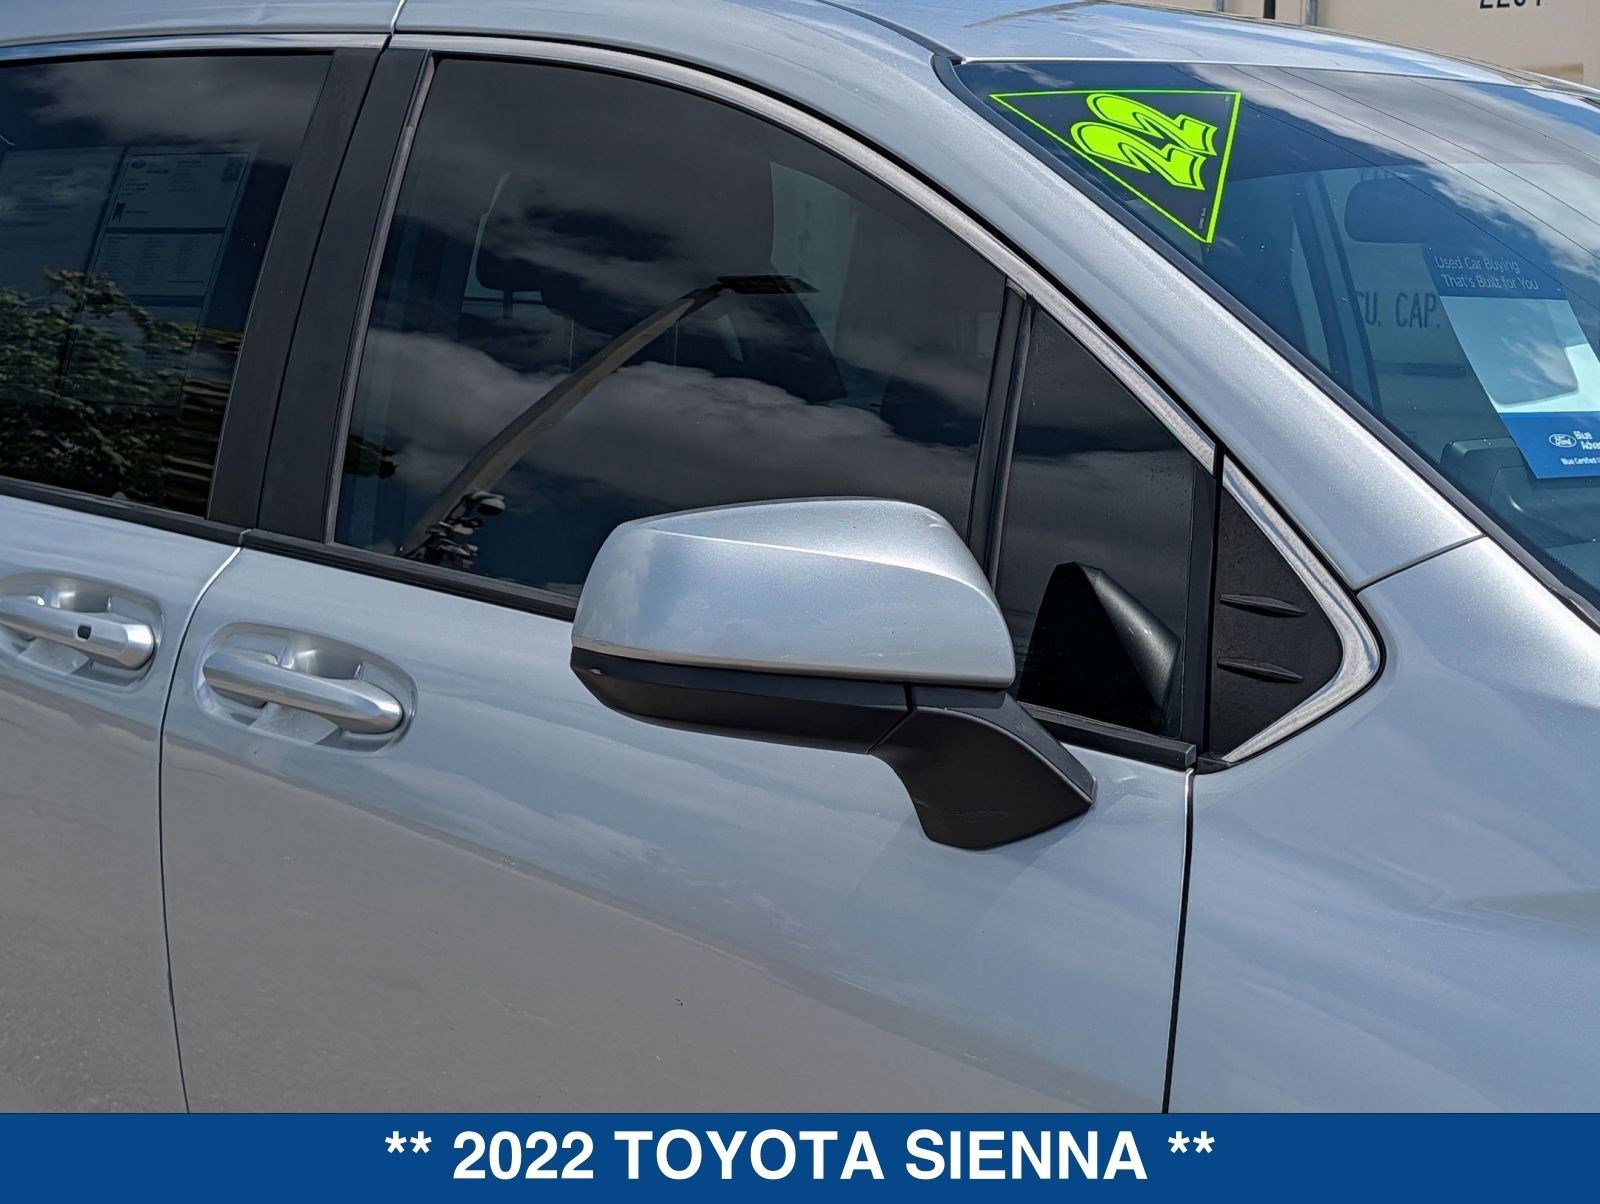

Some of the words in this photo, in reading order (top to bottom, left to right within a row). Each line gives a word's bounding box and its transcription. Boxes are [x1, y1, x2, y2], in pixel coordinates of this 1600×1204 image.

[1070, 93, 1218, 191] 22
[1434, 256, 1463, 269] Used
[1464, 257, 1481, 270] Car
[1483, 258, 1520, 274] Buying
[1441, 274, 1475, 288] That's
[1477, 276, 1501, 289] Built
[1502, 276, 1517, 289] for
[1517, 277, 1540, 290] You
[1395, 292, 1440, 329] CAP.
[1573, 430, 1593, 440] Blue
